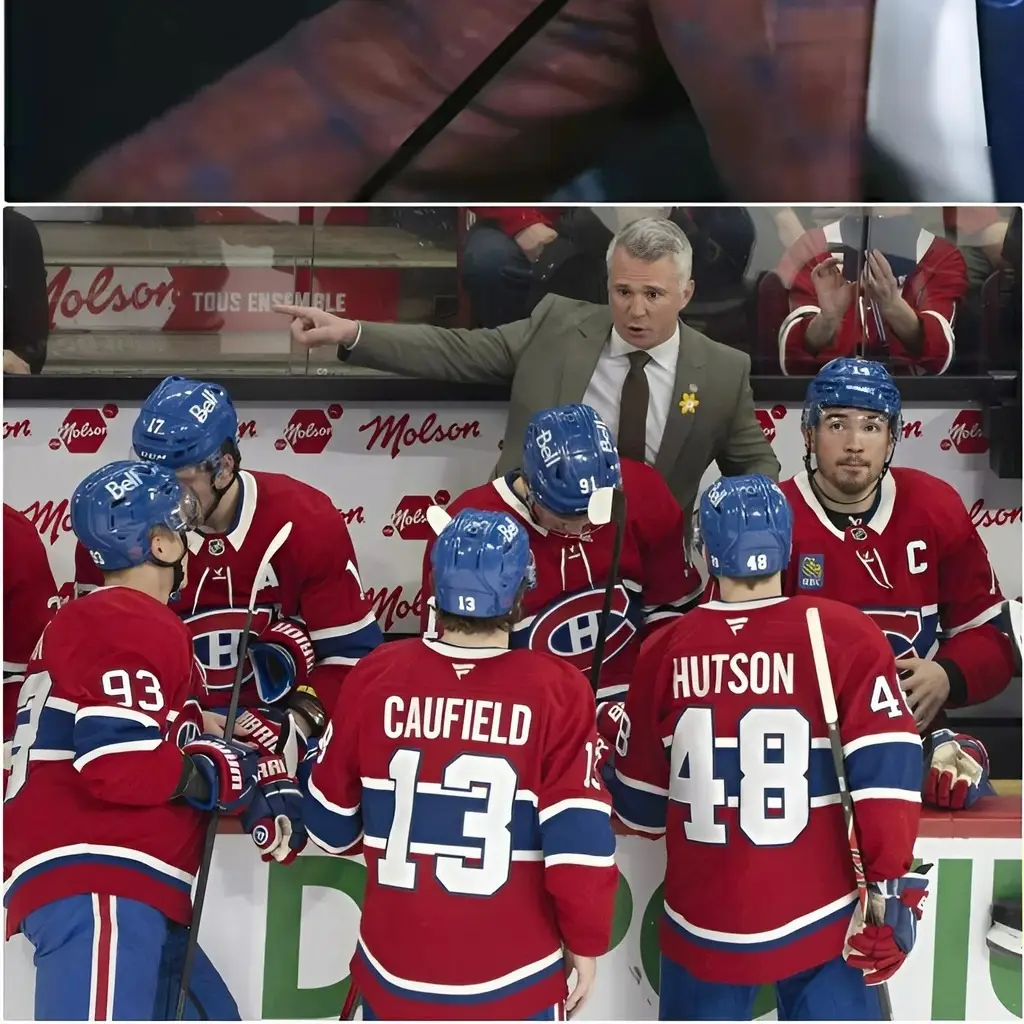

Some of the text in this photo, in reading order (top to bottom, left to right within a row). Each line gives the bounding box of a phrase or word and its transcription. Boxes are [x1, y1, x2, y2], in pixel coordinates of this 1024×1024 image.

[193, 292, 241, 313] TOUS
[248, 291, 347, 313] ENSEMBLE
[188, 388, 218, 424] Bell
[358, 412, 481, 459] Molson
[535, 428, 561, 468] Bell
[104, 468, 145, 501] Bell
[968, 498, 1022, 528] lson
[745, 553, 768, 572] 48
[906, 539, 928, 575] C
[457, 594, 477, 612] 13
[101, 668, 165, 713] 93
[672, 651, 795, 700] HUTSON
[383, 694, 533, 747] CAUFIELD
[667, 705, 811, 847] 48
[376, 747, 519, 898] 13
